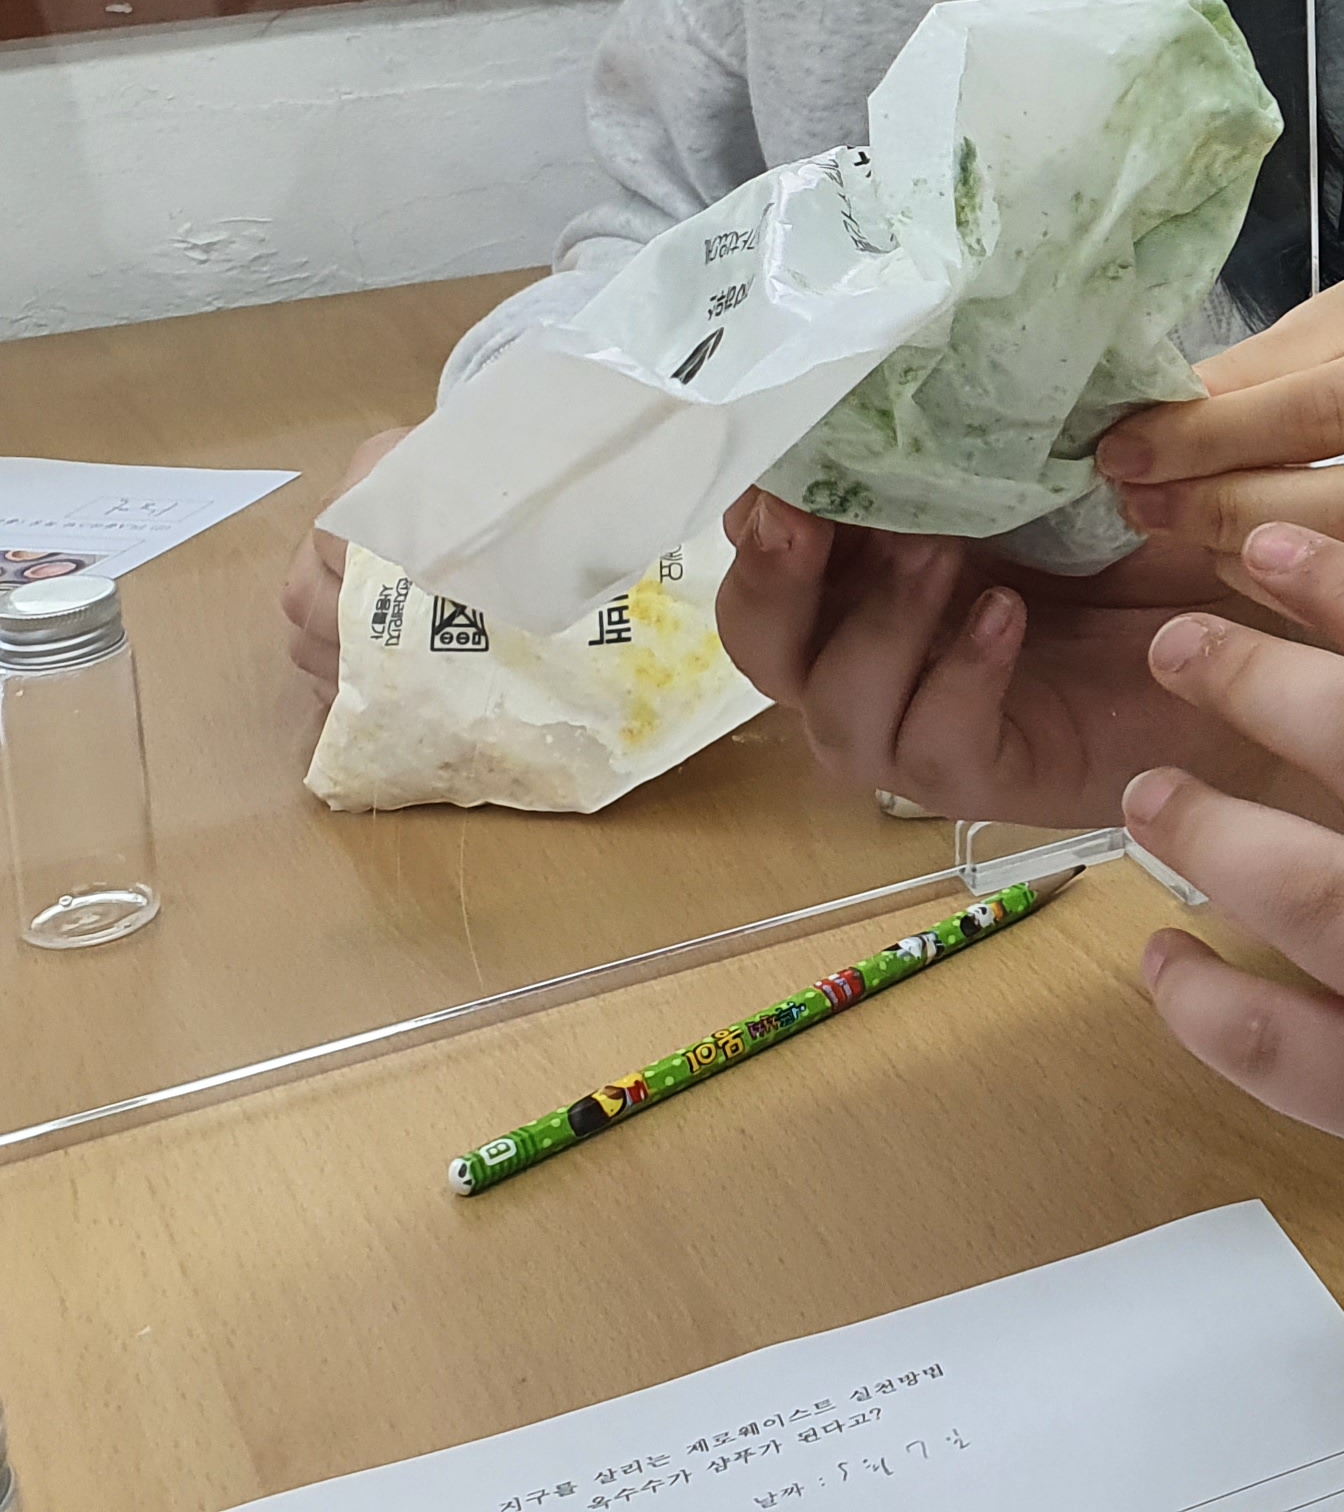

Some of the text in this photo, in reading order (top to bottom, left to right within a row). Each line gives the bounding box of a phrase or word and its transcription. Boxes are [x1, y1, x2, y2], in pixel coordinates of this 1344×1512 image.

[499, 1363, 945, 1512] 지구를 살리는 제로웨이스트 실천방법
[586, 1469, 694, 1511] 옥수수가
[797, 1407, 883, 1443] 된다고?
